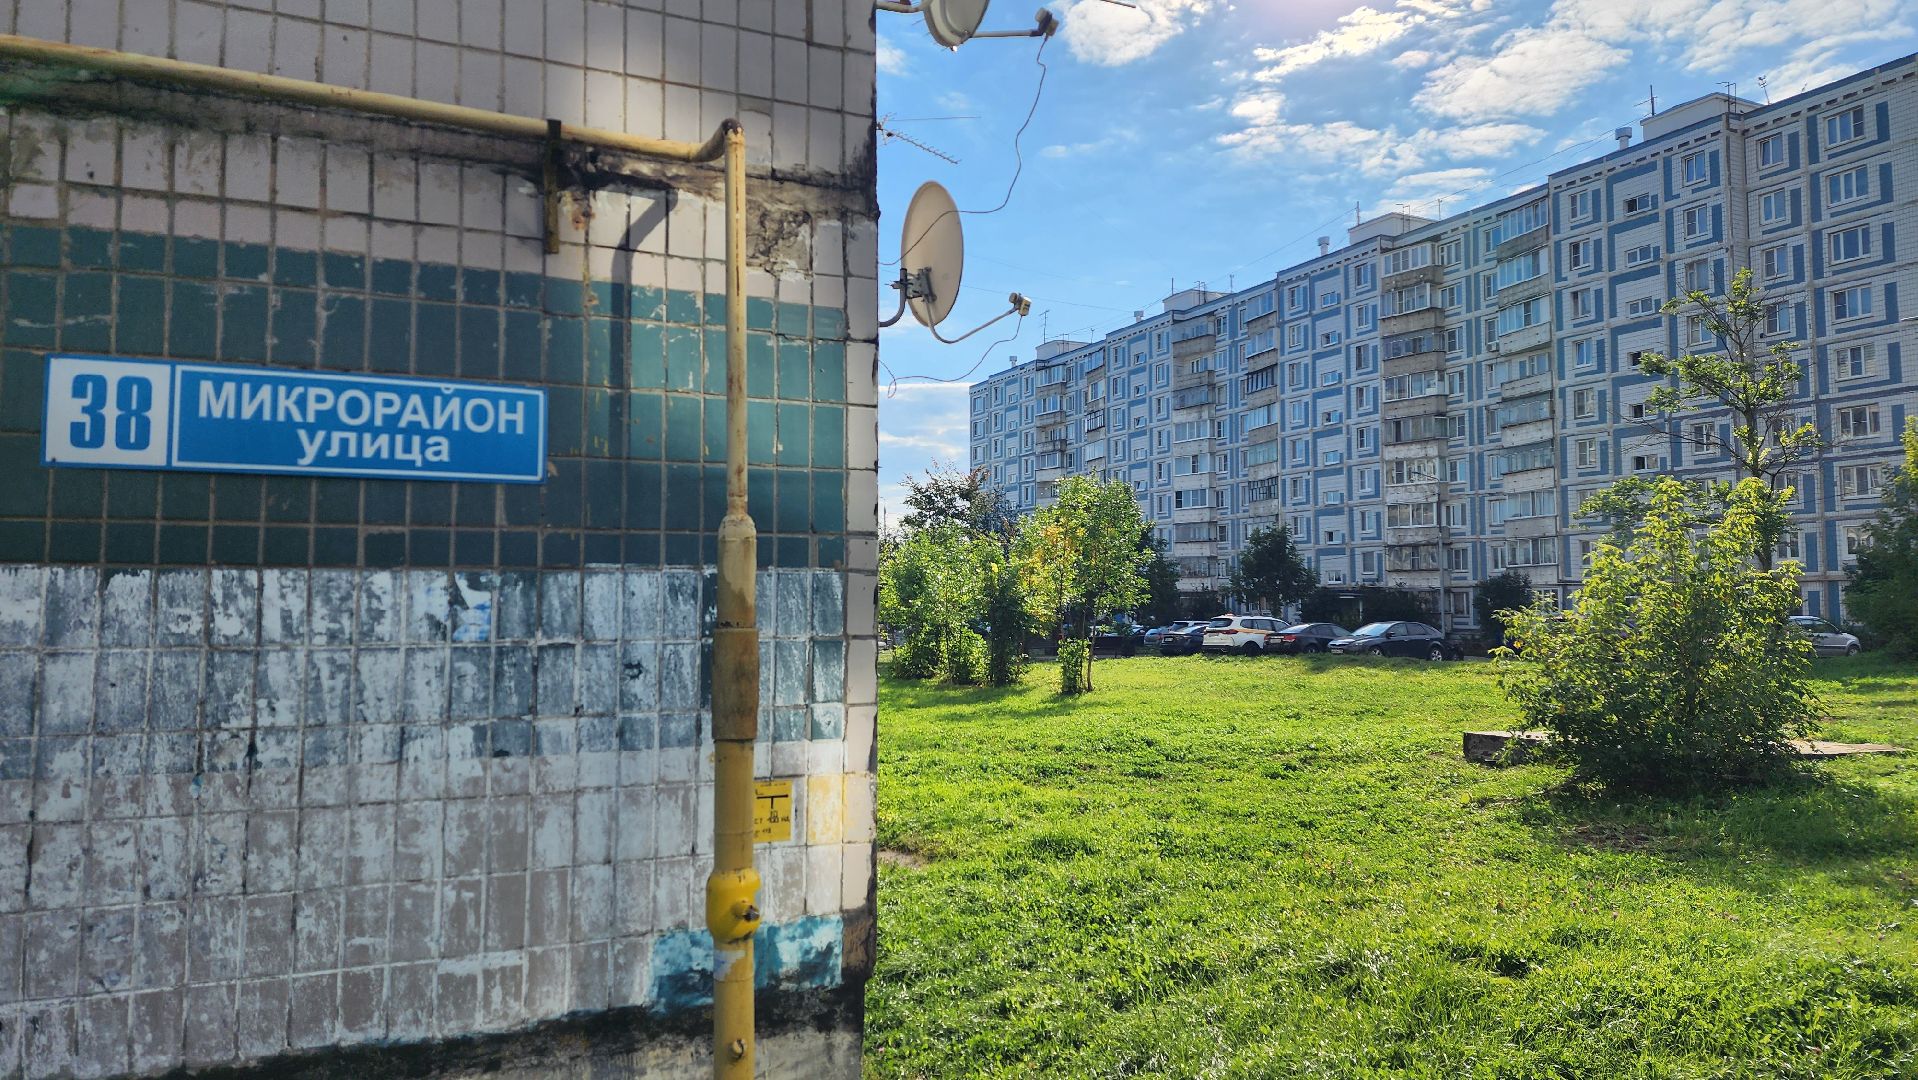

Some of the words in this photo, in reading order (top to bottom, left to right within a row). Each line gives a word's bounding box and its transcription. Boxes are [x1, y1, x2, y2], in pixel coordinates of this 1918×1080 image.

[69, 374, 153, 452] 38
[198, 380, 525, 435] МИКРОРАЙОН
[298, 429, 450, 467] улица
